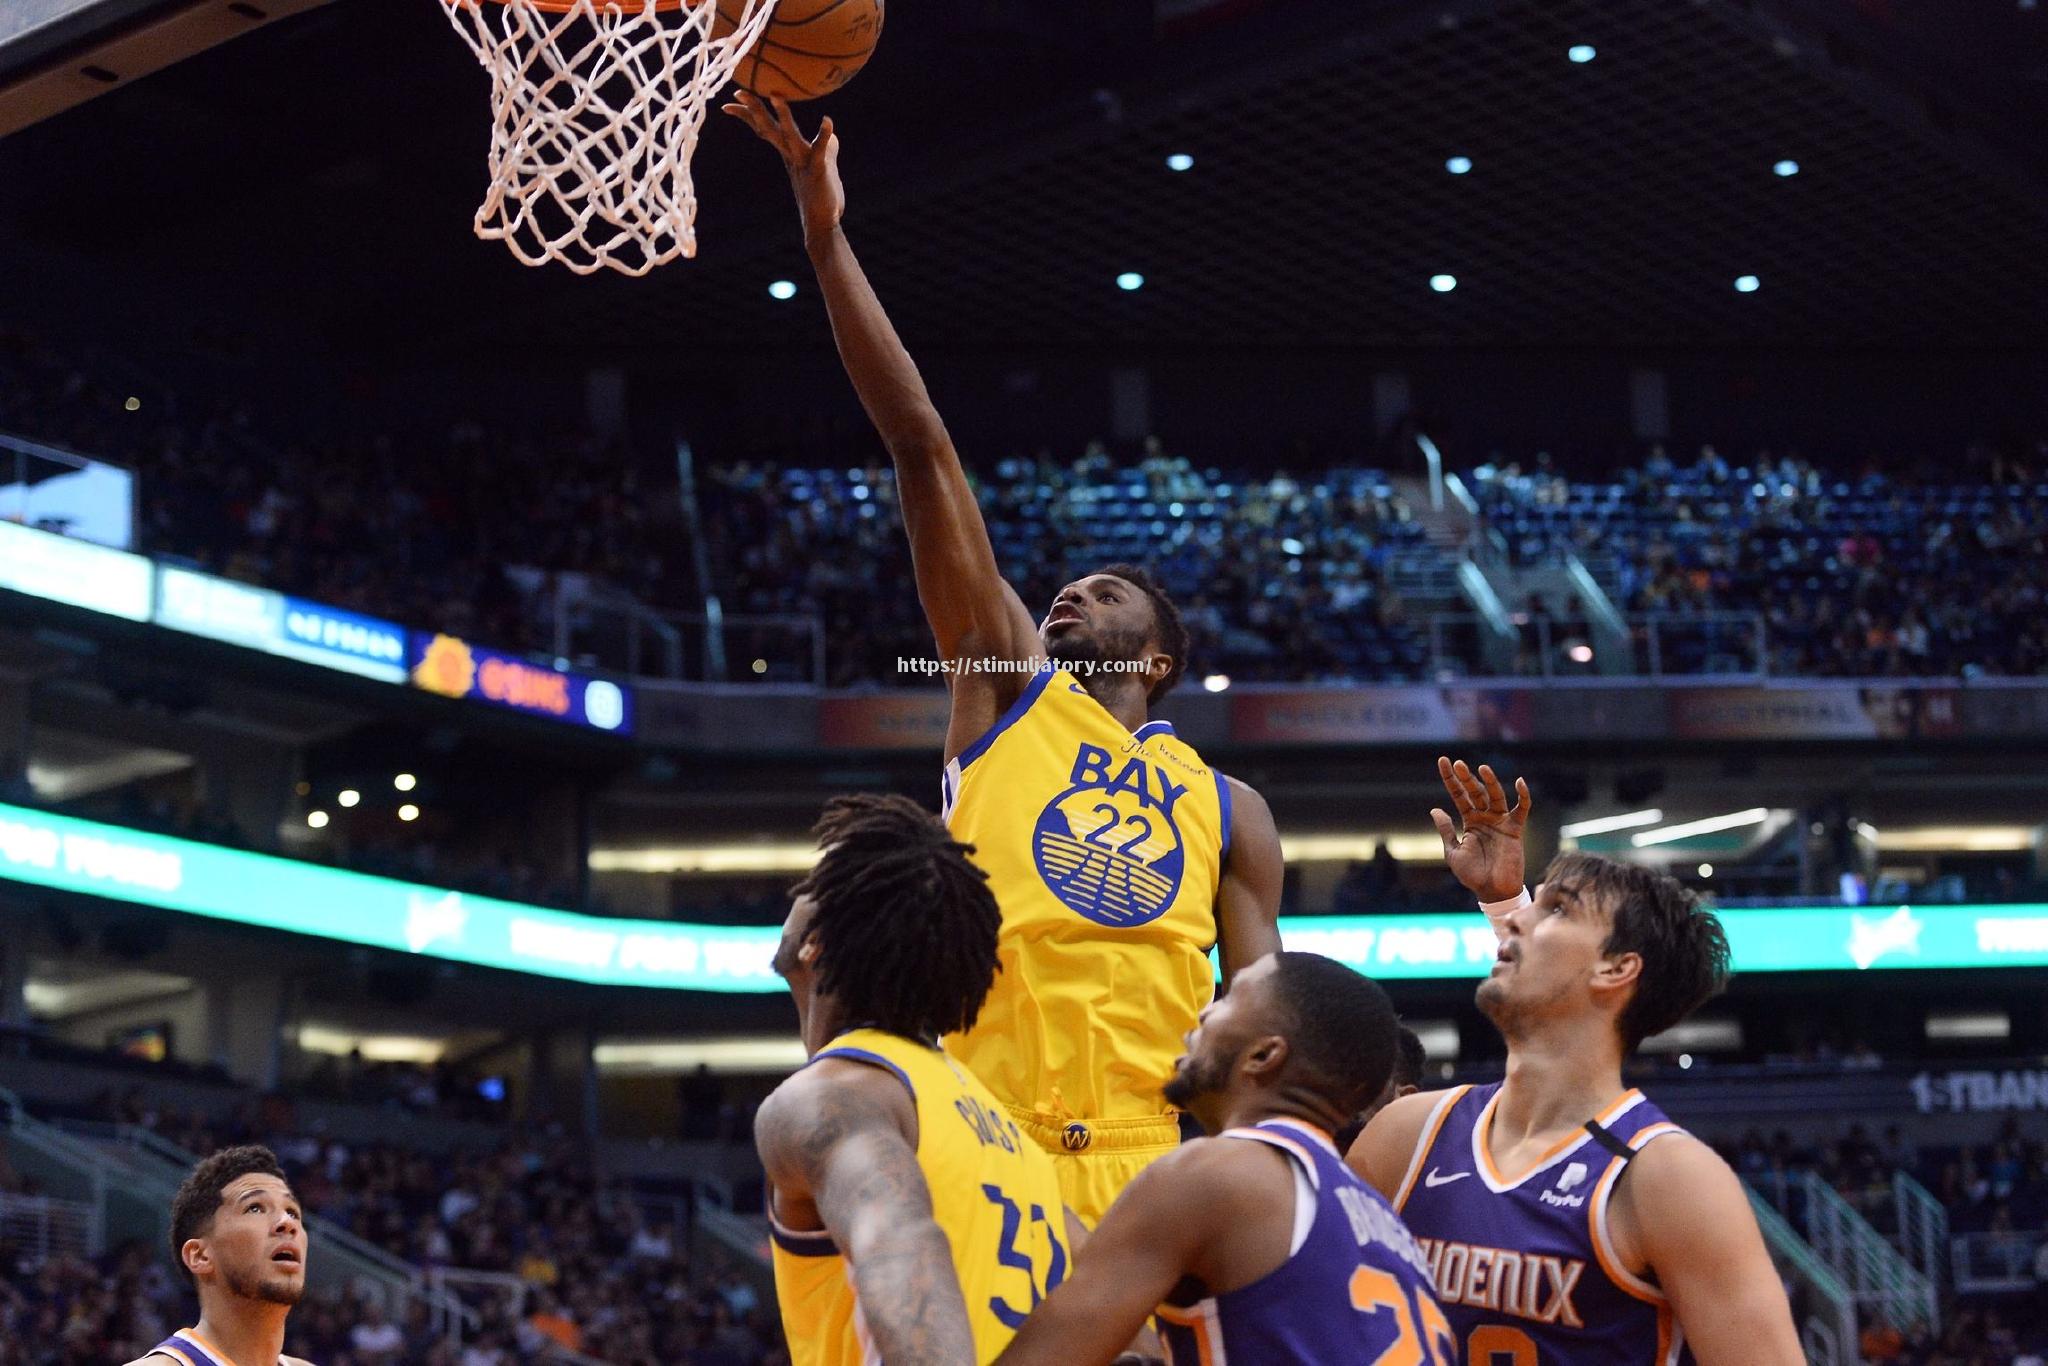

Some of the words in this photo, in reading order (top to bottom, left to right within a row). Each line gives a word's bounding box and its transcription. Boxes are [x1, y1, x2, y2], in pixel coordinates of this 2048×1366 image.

[1070, 742, 1188, 817] BAY
[1084, 803, 1152, 864] 22
[1540, 1189, 1585, 1207] PayPal
[1418, 1237, 1586, 1329] HOENIX
